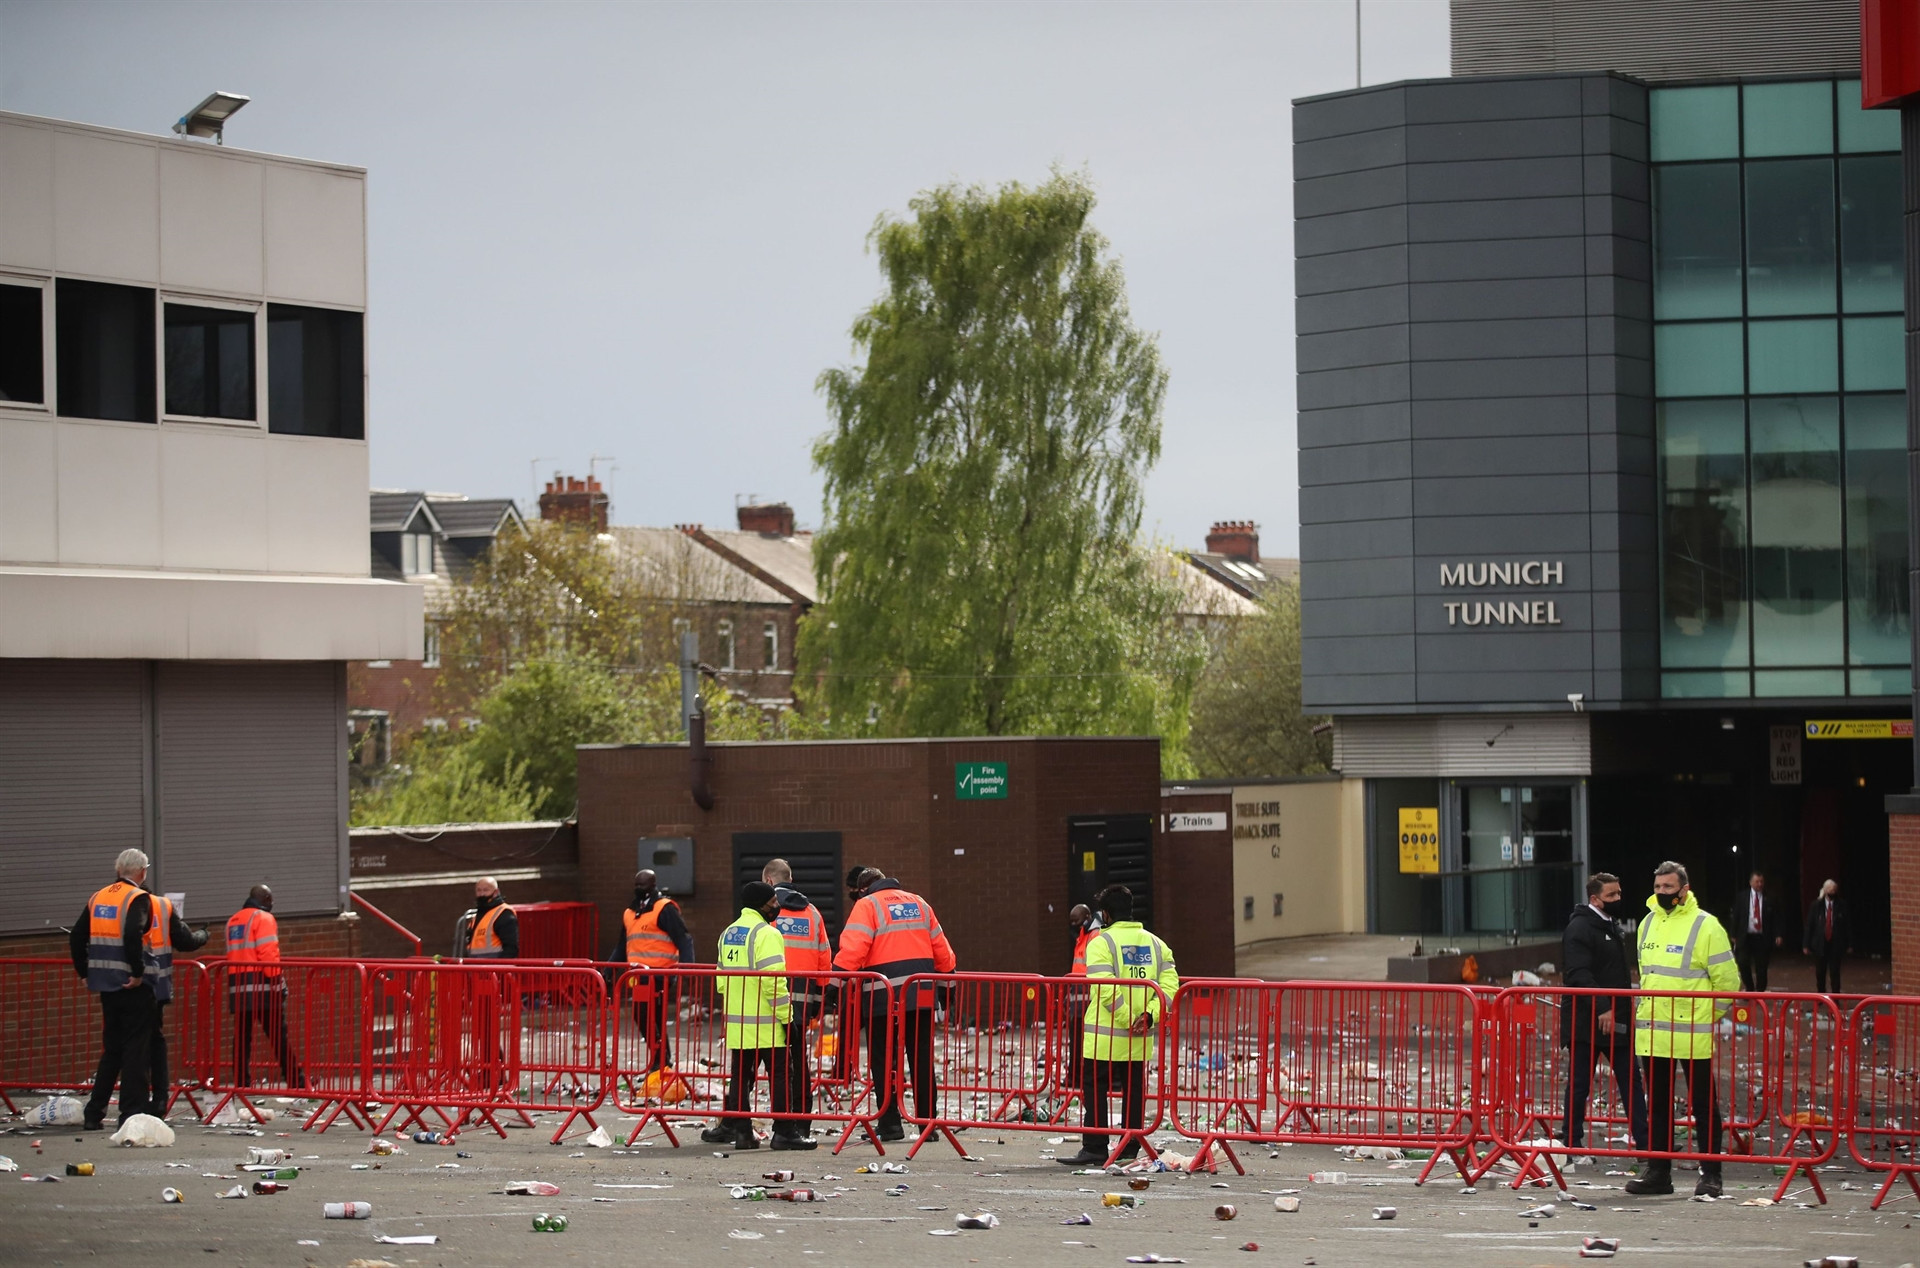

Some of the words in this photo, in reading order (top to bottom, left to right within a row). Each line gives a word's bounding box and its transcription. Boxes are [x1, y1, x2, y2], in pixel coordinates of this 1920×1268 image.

[1440, 561, 1563, 586] MUNICH
[1443, 601, 1561, 625] TUNNEL
[1772, 728, 1799, 738] STOP
[1780, 743, 1792, 753] AT
[1776, 757, 1795, 767] RED
[973, 776, 1004, 785] assembly
[1771, 770, 1800, 781] LIGHT
[980, 786, 997, 794] point
[1261, 801, 1280, 816] SUITE
[1182, 816, 1213, 826] Trains
[1261, 823, 1280, 838] SUITE
[902, 908, 920, 917] CSG
[791, 924, 809, 934] CSG
[734, 934, 747, 942] CSG
[727, 949, 739, 962] 41
[1134, 953, 1151, 962] CSG
[1129, 966, 1146, 978] 106
